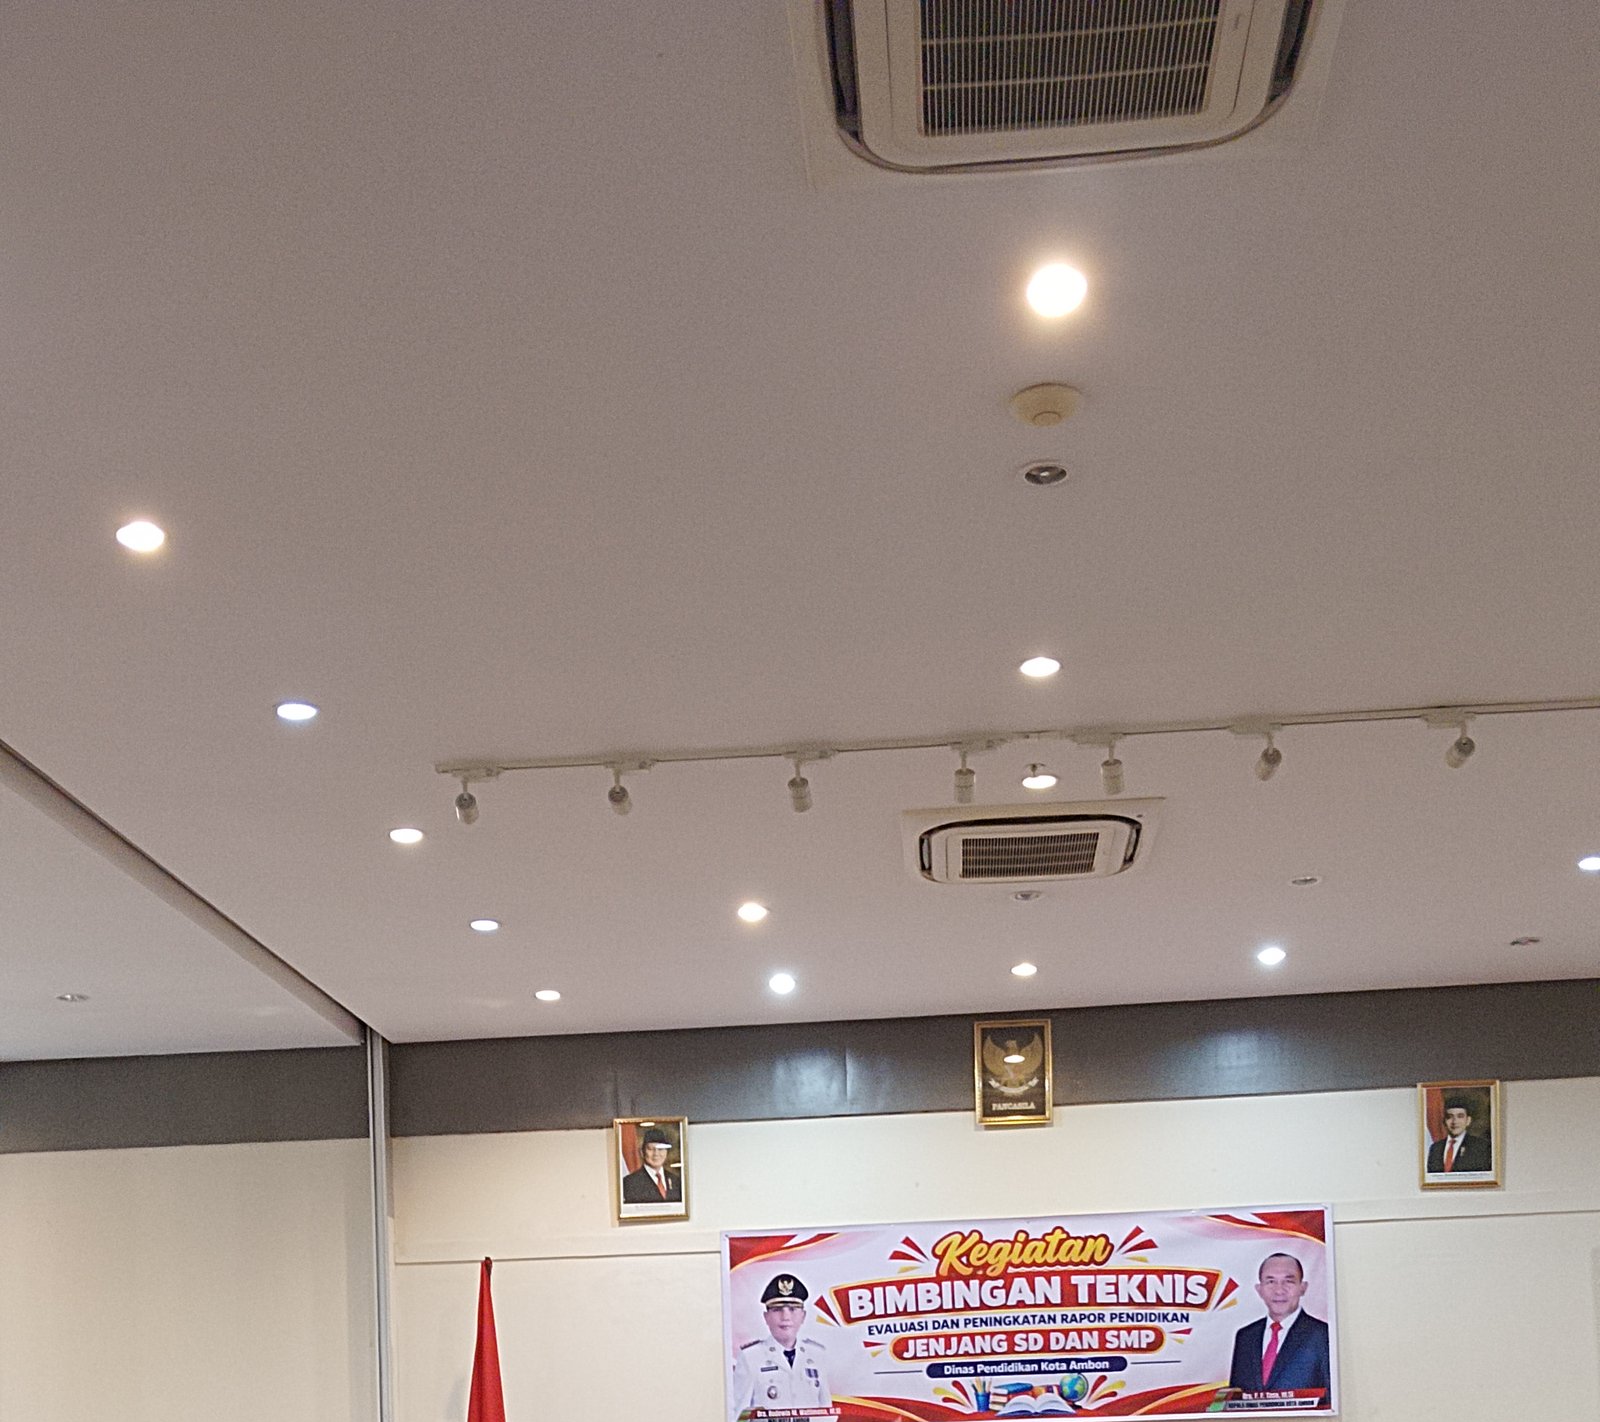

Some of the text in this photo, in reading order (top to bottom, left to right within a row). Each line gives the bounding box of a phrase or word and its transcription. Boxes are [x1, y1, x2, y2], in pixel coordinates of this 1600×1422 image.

[933, 1227, 1113, 1277] Kegiatan
[848, 1274, 1208, 1318] BIMBINGAN TEKNIS
[868, 1312, 1189, 1335] EVALUASI DAN PENINGKATAN RAPOR PENDIDIKAN
[903, 1330, 1155, 1358] JENJANG SD DAN SMP
[944, 1360, 1109, 1375] Dinas Pendidikan Kota Ambon
